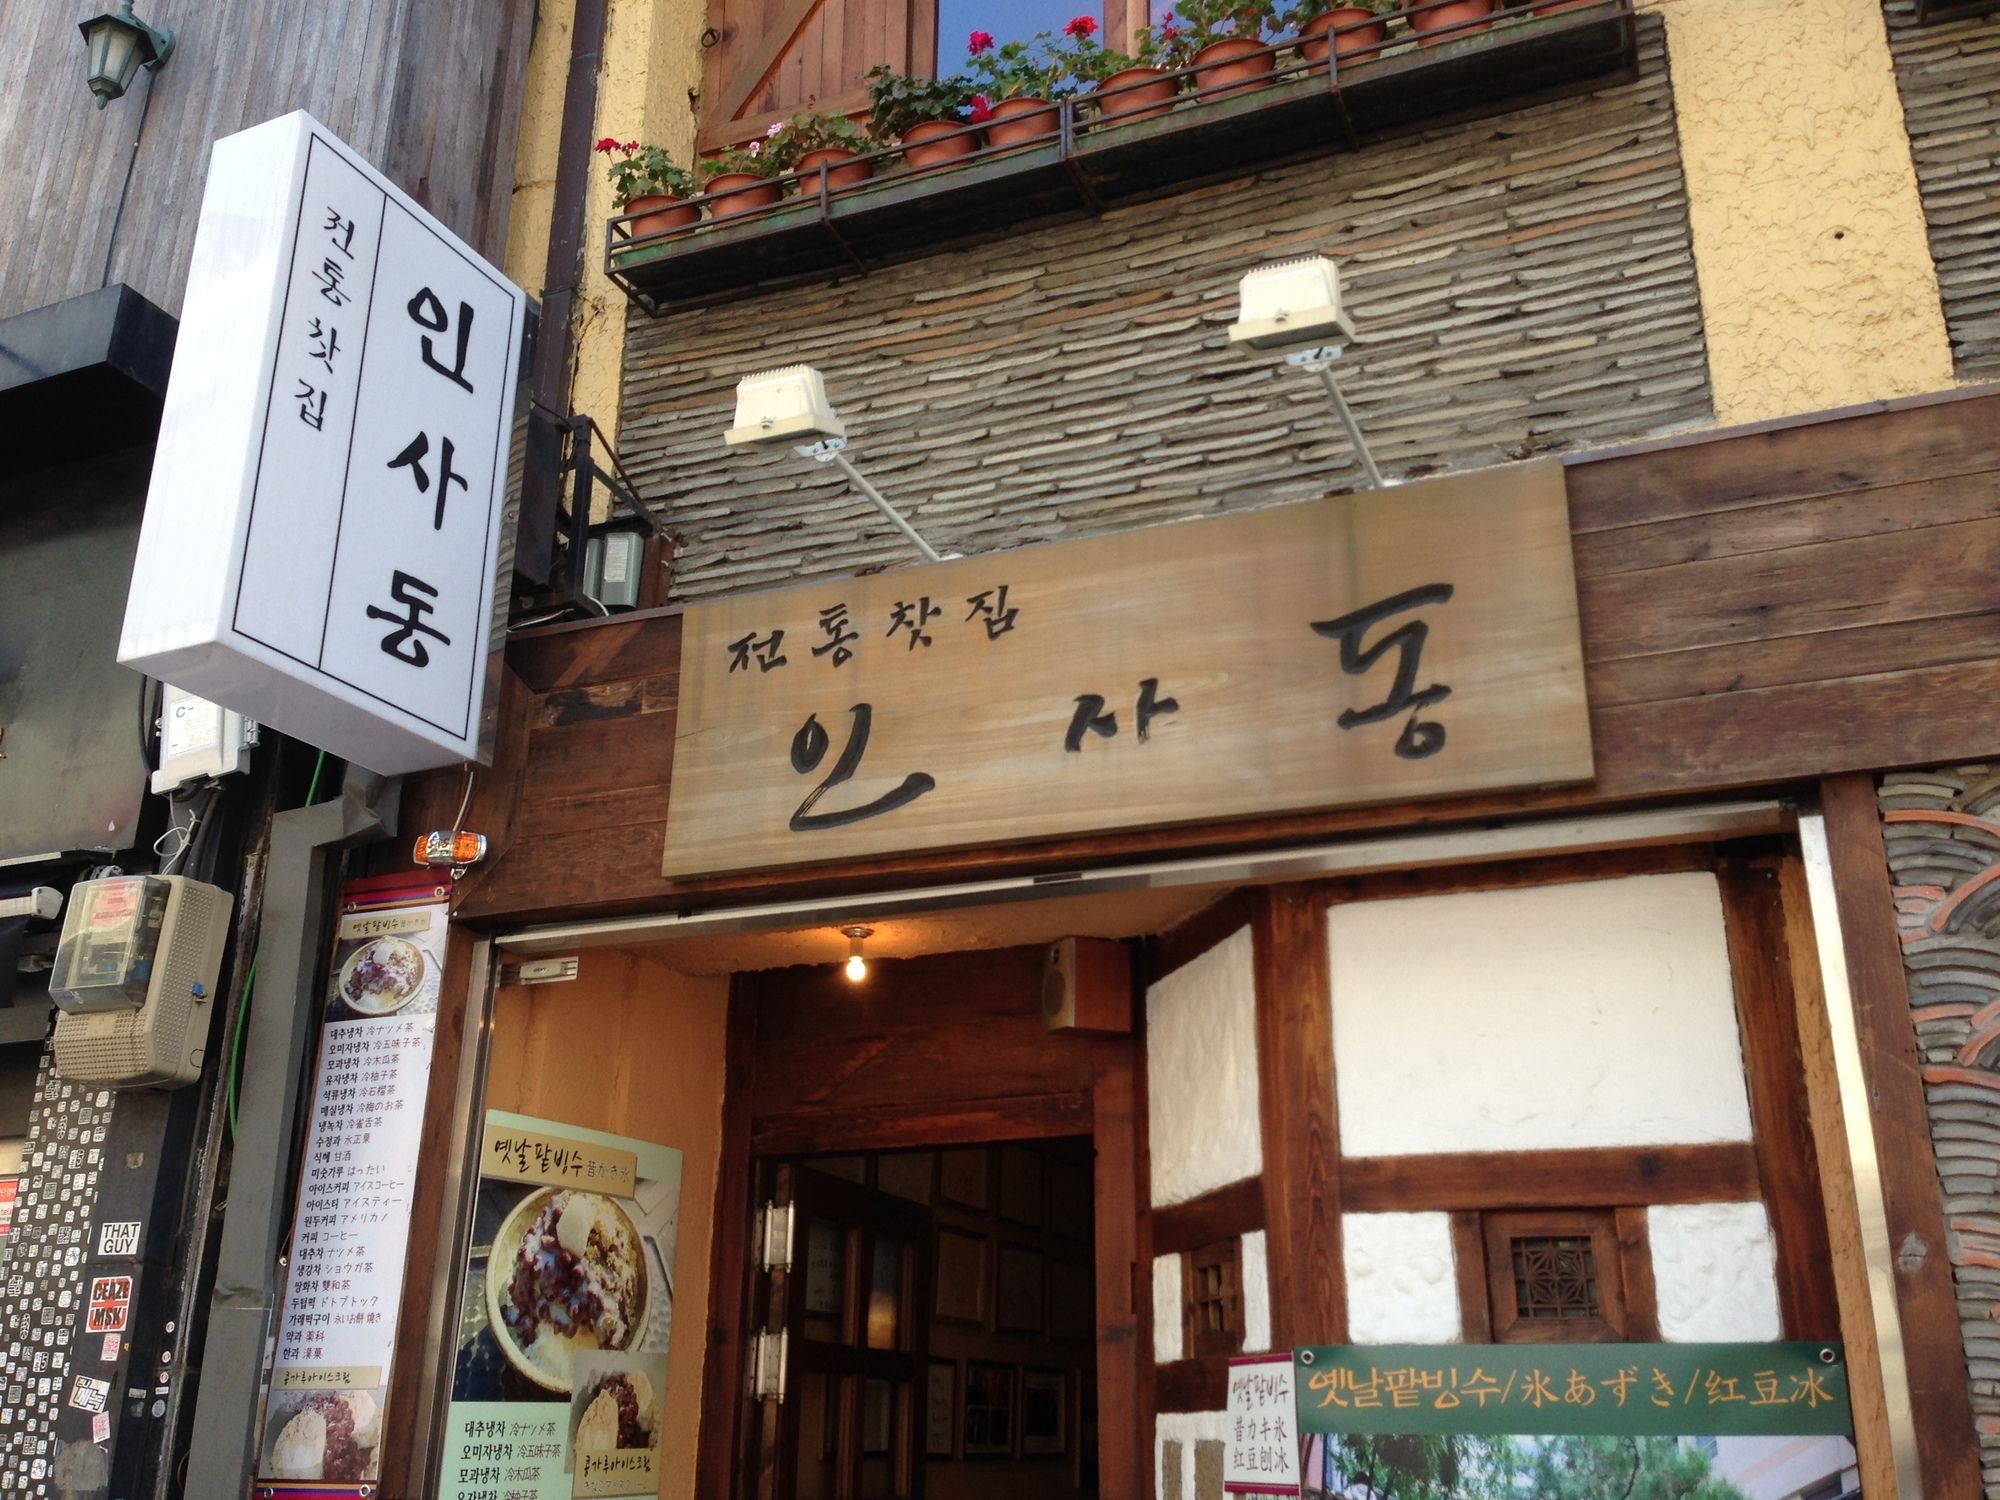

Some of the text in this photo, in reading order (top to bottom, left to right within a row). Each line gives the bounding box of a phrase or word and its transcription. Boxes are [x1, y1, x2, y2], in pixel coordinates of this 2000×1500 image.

[295, 205, 356, 432] 전통찻집
[367, 285, 475, 669] 인사동
[727, 584, 1020, 675] 전통찻집
[790, 582, 1456, 832] 인사동
[330, 1026, 363, 1040] 대추냉차
[328, 1041, 370, 1055] 오미자냉차
[327, 1057, 360, 1070] 모과냉차
[325, 1072, 358, 1086] 유자냉차
[323, 1087, 356, 1101] 석류냉차
[320, 1103, 354, 1117] 매실냉차
[318, 1119, 343, 1132] 냉녹차
[316, 1135, 341, 1148] 수정과
[334, 1150, 351, 1162] 甘酒
[494, 1138, 584, 1178] 옛날팥빙수
[311, 1166, 345, 1180] 미숫가루
[308, 1179, 405, 1196] 아이스커피 アイスコーヒー
[306, 1196, 402, 1212] 아이스티 アイスティー
[304, 1213, 388, 1228] 원두커피 アメリカノ
[104, 1223, 140, 1238] THAT
[301, 1230, 358, 1244] 커피 コーヒー
[103, 1238, 134, 1254] GUY
[299, 1246, 365, 1260] 대추차 ナツメ茶
[296, 1262, 374, 1277] 생강차 ショウガ茶
[294, 1281, 319, 1294] 쌍화차
[288, 1312, 331, 1327] 가래떡구이
[286, 1331, 302, 1342] 약과
[464, 1421, 556, 1438] 대추냉차 冷ナツメ茶
[460, 1443, 562, 1461] 오미자냉차 冷五味子茶
[458, 1467, 541, 1485] 모과냉차 冷木瓜茶
